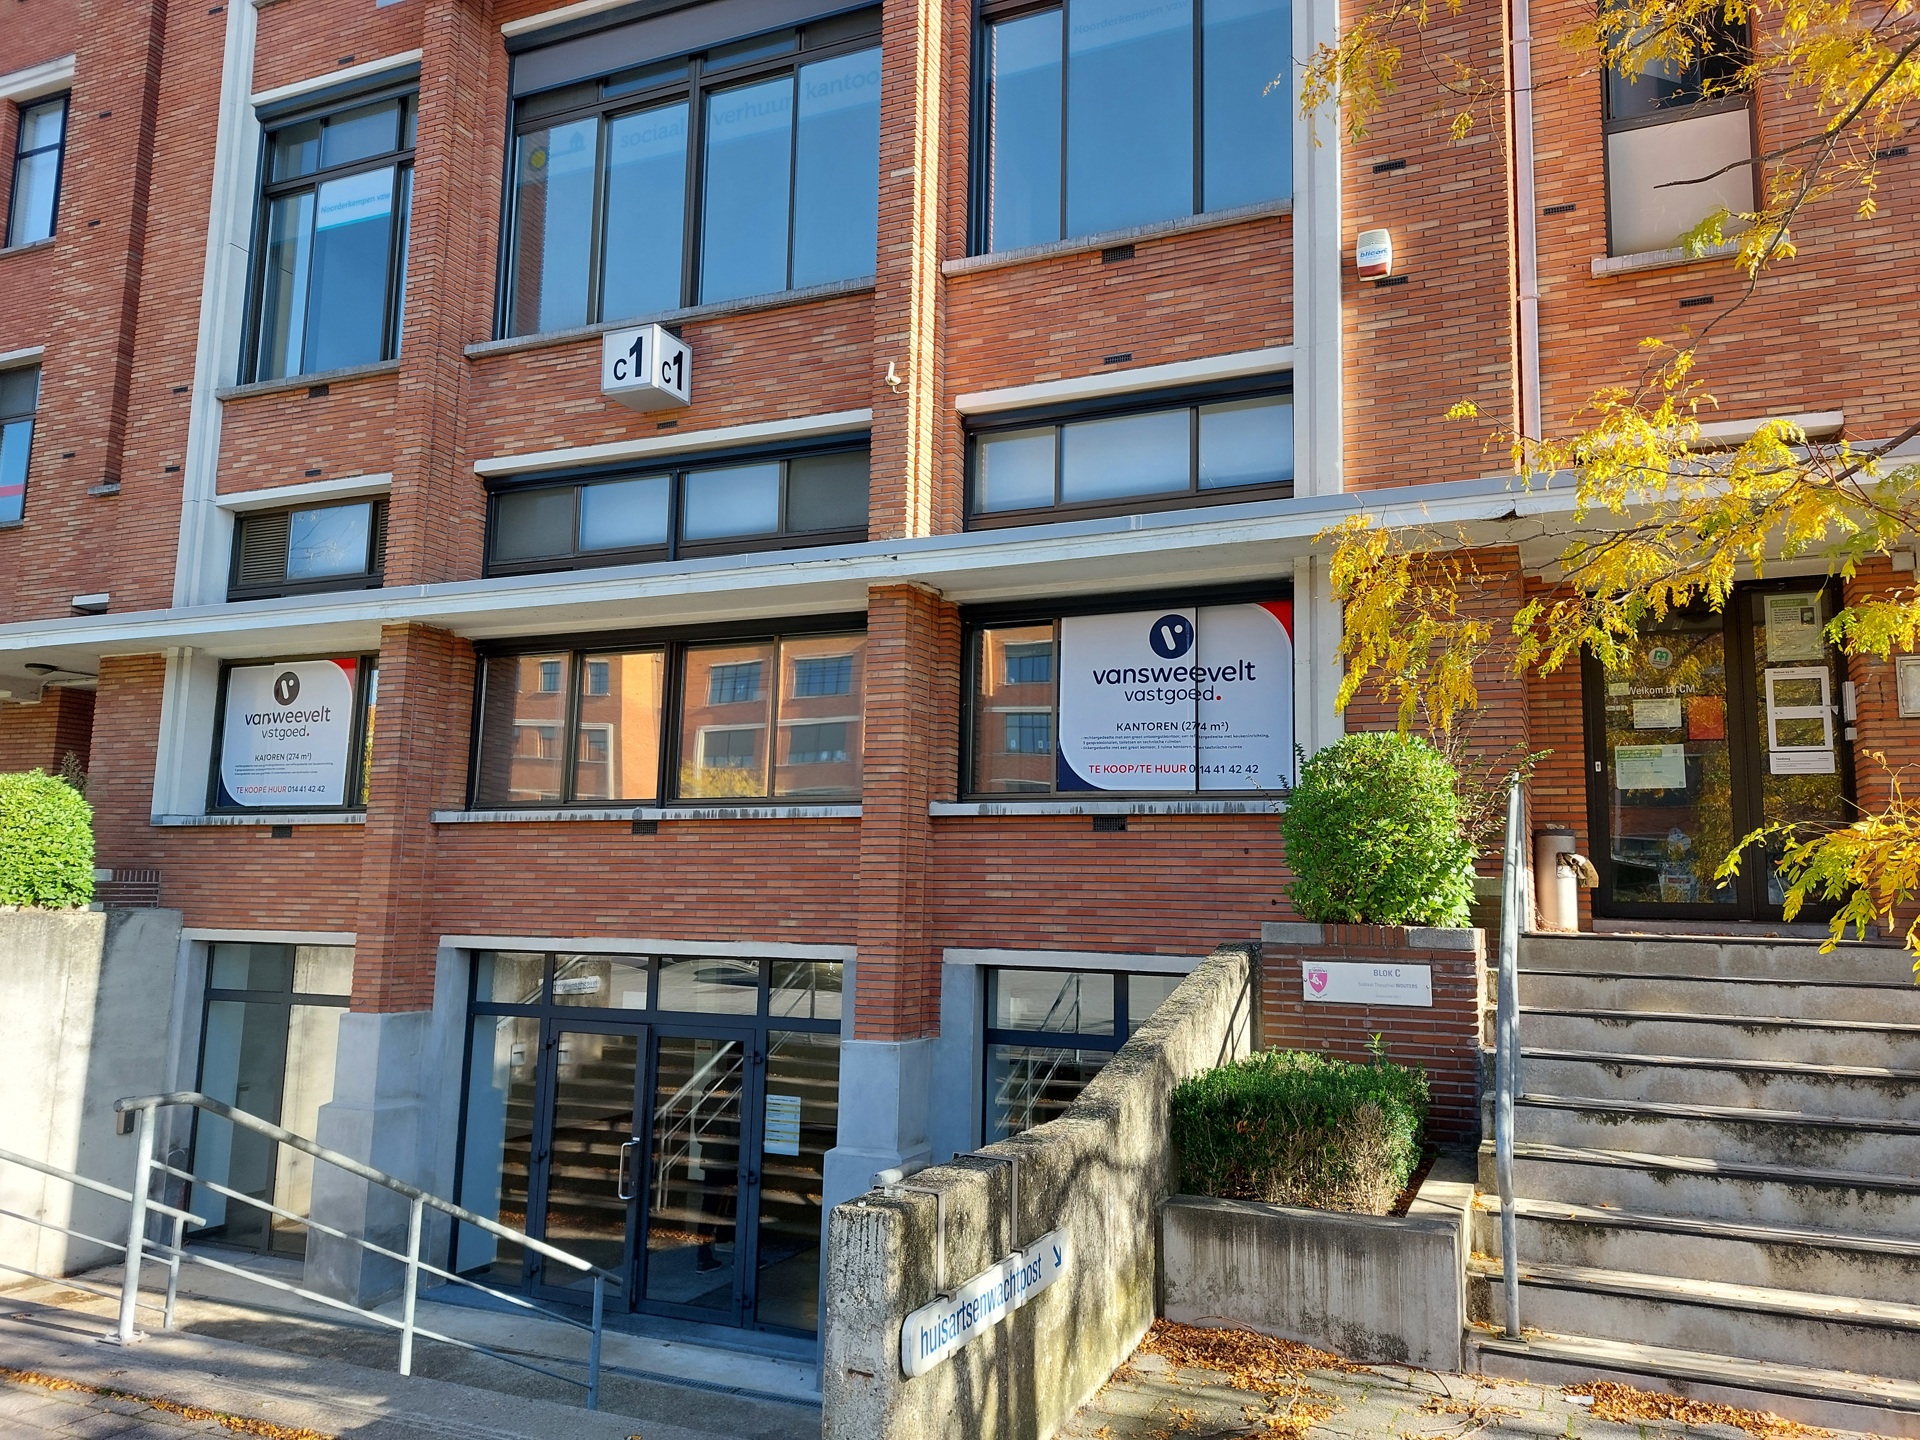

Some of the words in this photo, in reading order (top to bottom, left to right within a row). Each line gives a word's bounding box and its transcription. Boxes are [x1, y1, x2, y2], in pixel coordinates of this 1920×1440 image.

[1073, 5, 1163, 34] Noorderkempen
[619, 117, 685, 148] sociaal
[713, 96, 793, 126] verhuur
[320, 196, 376, 213] Noorderkempen
[377, 192, 391, 201] vzw
[1092, 659, 1256, 685] vansweevelt
[1124, 685, 1222, 705] vastgoed.
[1629, 686, 1663, 695] Welkom
[1116, 722, 1178, 731] KANTOREN
[1181, 721, 1207, 732] (274
[1210, 721, 1229, 732] m²)
[1089, 764, 1101, 774] TE
[1103, 764, 1152, 774] KOOP/TE
[1155, 764, 1187, 774] HUUR
[1213, 764, 1225, 774] 41
[1228, 764, 1242, 774] 42
[1245, 764, 1258, 774] 42
[267, 785, 287, 794] HUUR
[317, 785, 325, 793] 42
[1373, 969, 1393, 977] BLOK
[1394, 968, 1401, 978] C
[920, 1253, 1042, 1359] huisartsenwachtpost
